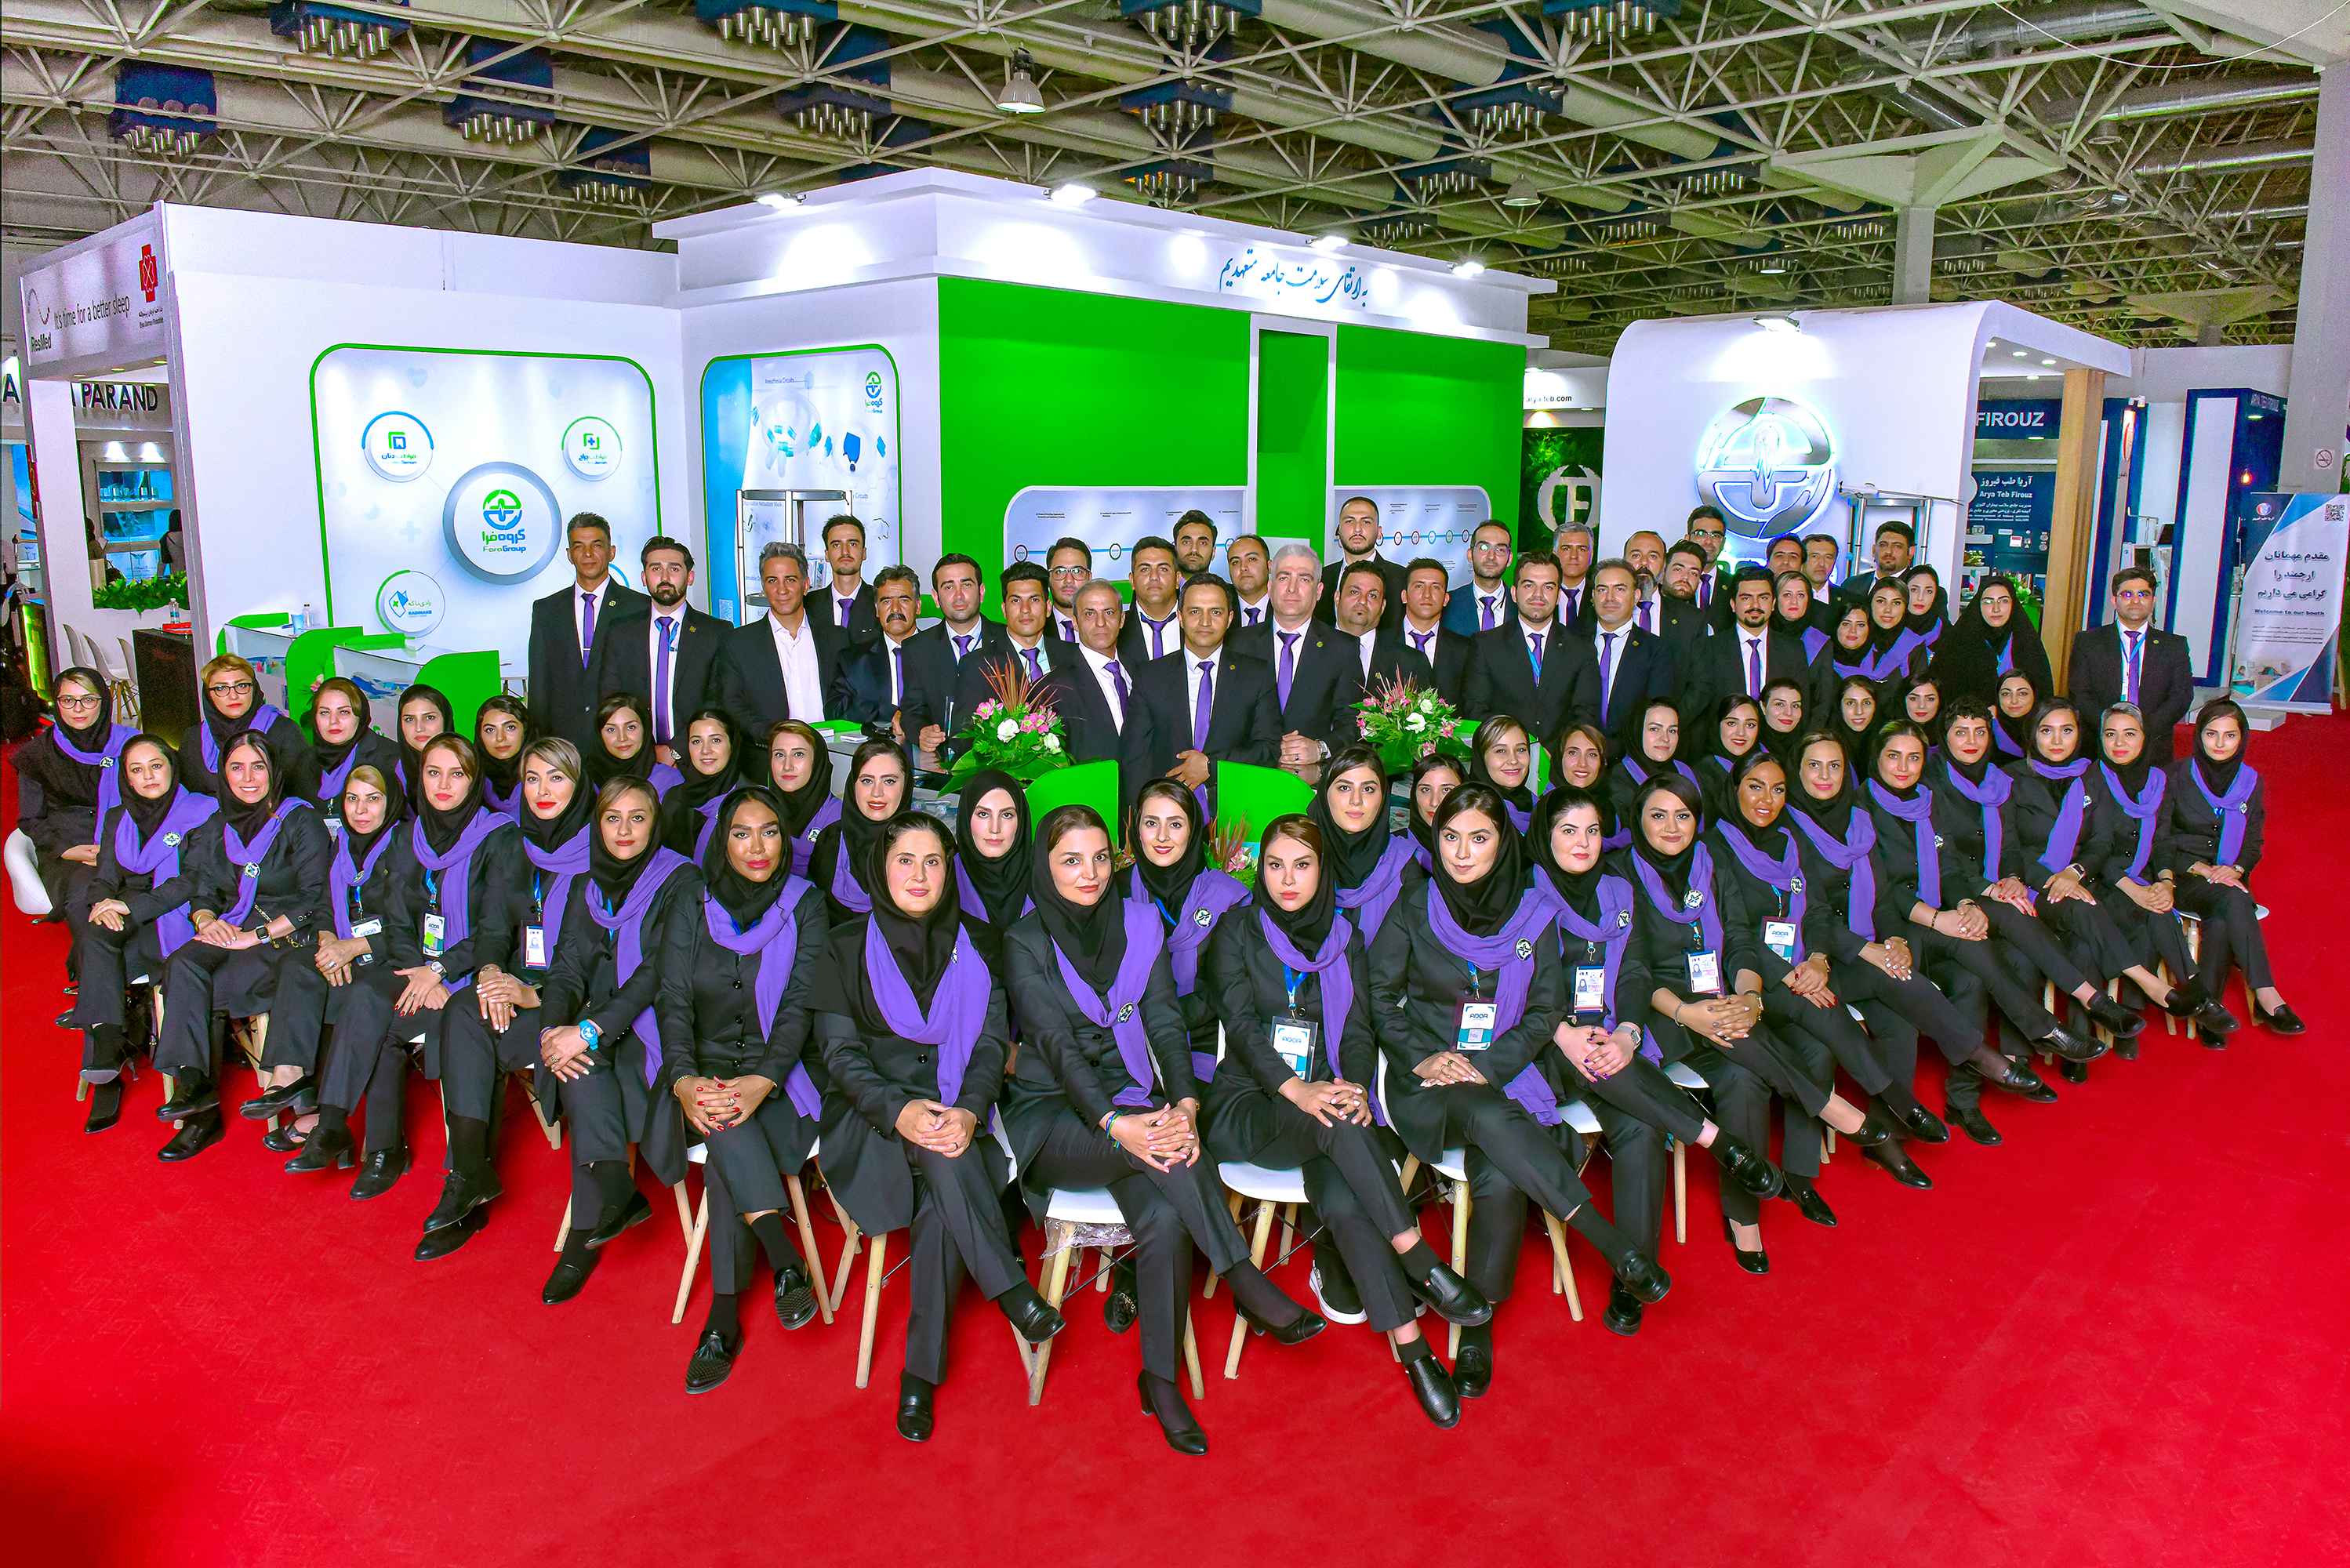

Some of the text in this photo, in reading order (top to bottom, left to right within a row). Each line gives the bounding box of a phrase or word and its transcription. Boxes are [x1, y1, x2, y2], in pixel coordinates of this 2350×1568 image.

[1260, 262, 1285, 296] جامعه
[77, 303, 86, 324] for
[87, 306, 92, 321] a
[92, 299, 111, 321] better
[112, 292, 130, 318] sleep
[31, 332, 52, 353] ResMed
[81, 383, 158, 412] PARAND
[1976, 412, 2045, 426] FIROUZ
[1980, 475, 2033, 487] آریا طب فیروز
[2265, 550, 2330, 563] مقدم مهمانان
[2274, 569, 2315, 582] ارجمند را
[2257, 588, 2281, 600] داریم
